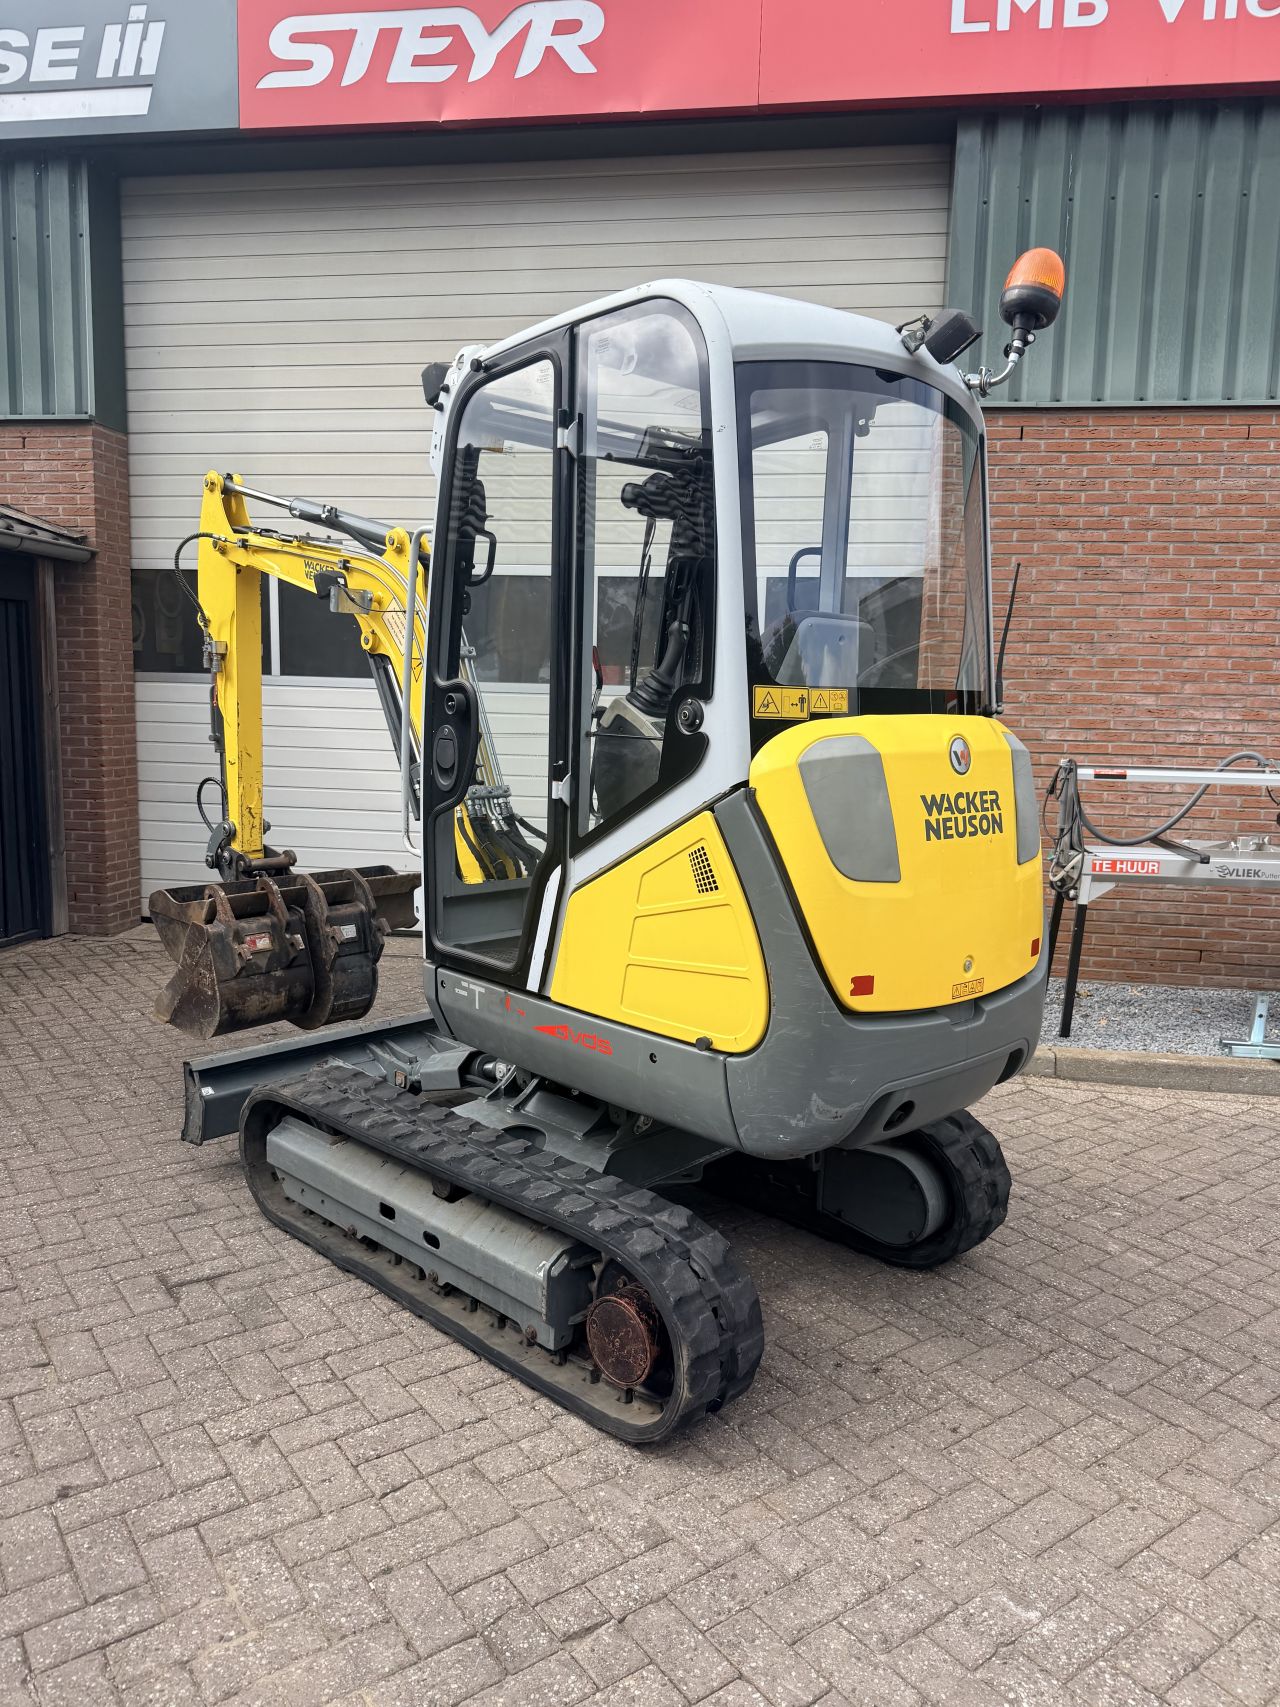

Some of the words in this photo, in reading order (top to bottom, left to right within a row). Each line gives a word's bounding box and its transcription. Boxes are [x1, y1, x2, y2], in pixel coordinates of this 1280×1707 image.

[256, 0, 605, 89] STEYR
[920, 790, 1002, 817] WACKER
[924, 813, 1004, 842] NEUSON
[1093, 860, 1112, 872] TE
[1115, 860, 1159, 874] HUUR
[1227, 867, 1262, 878] VLIEK
